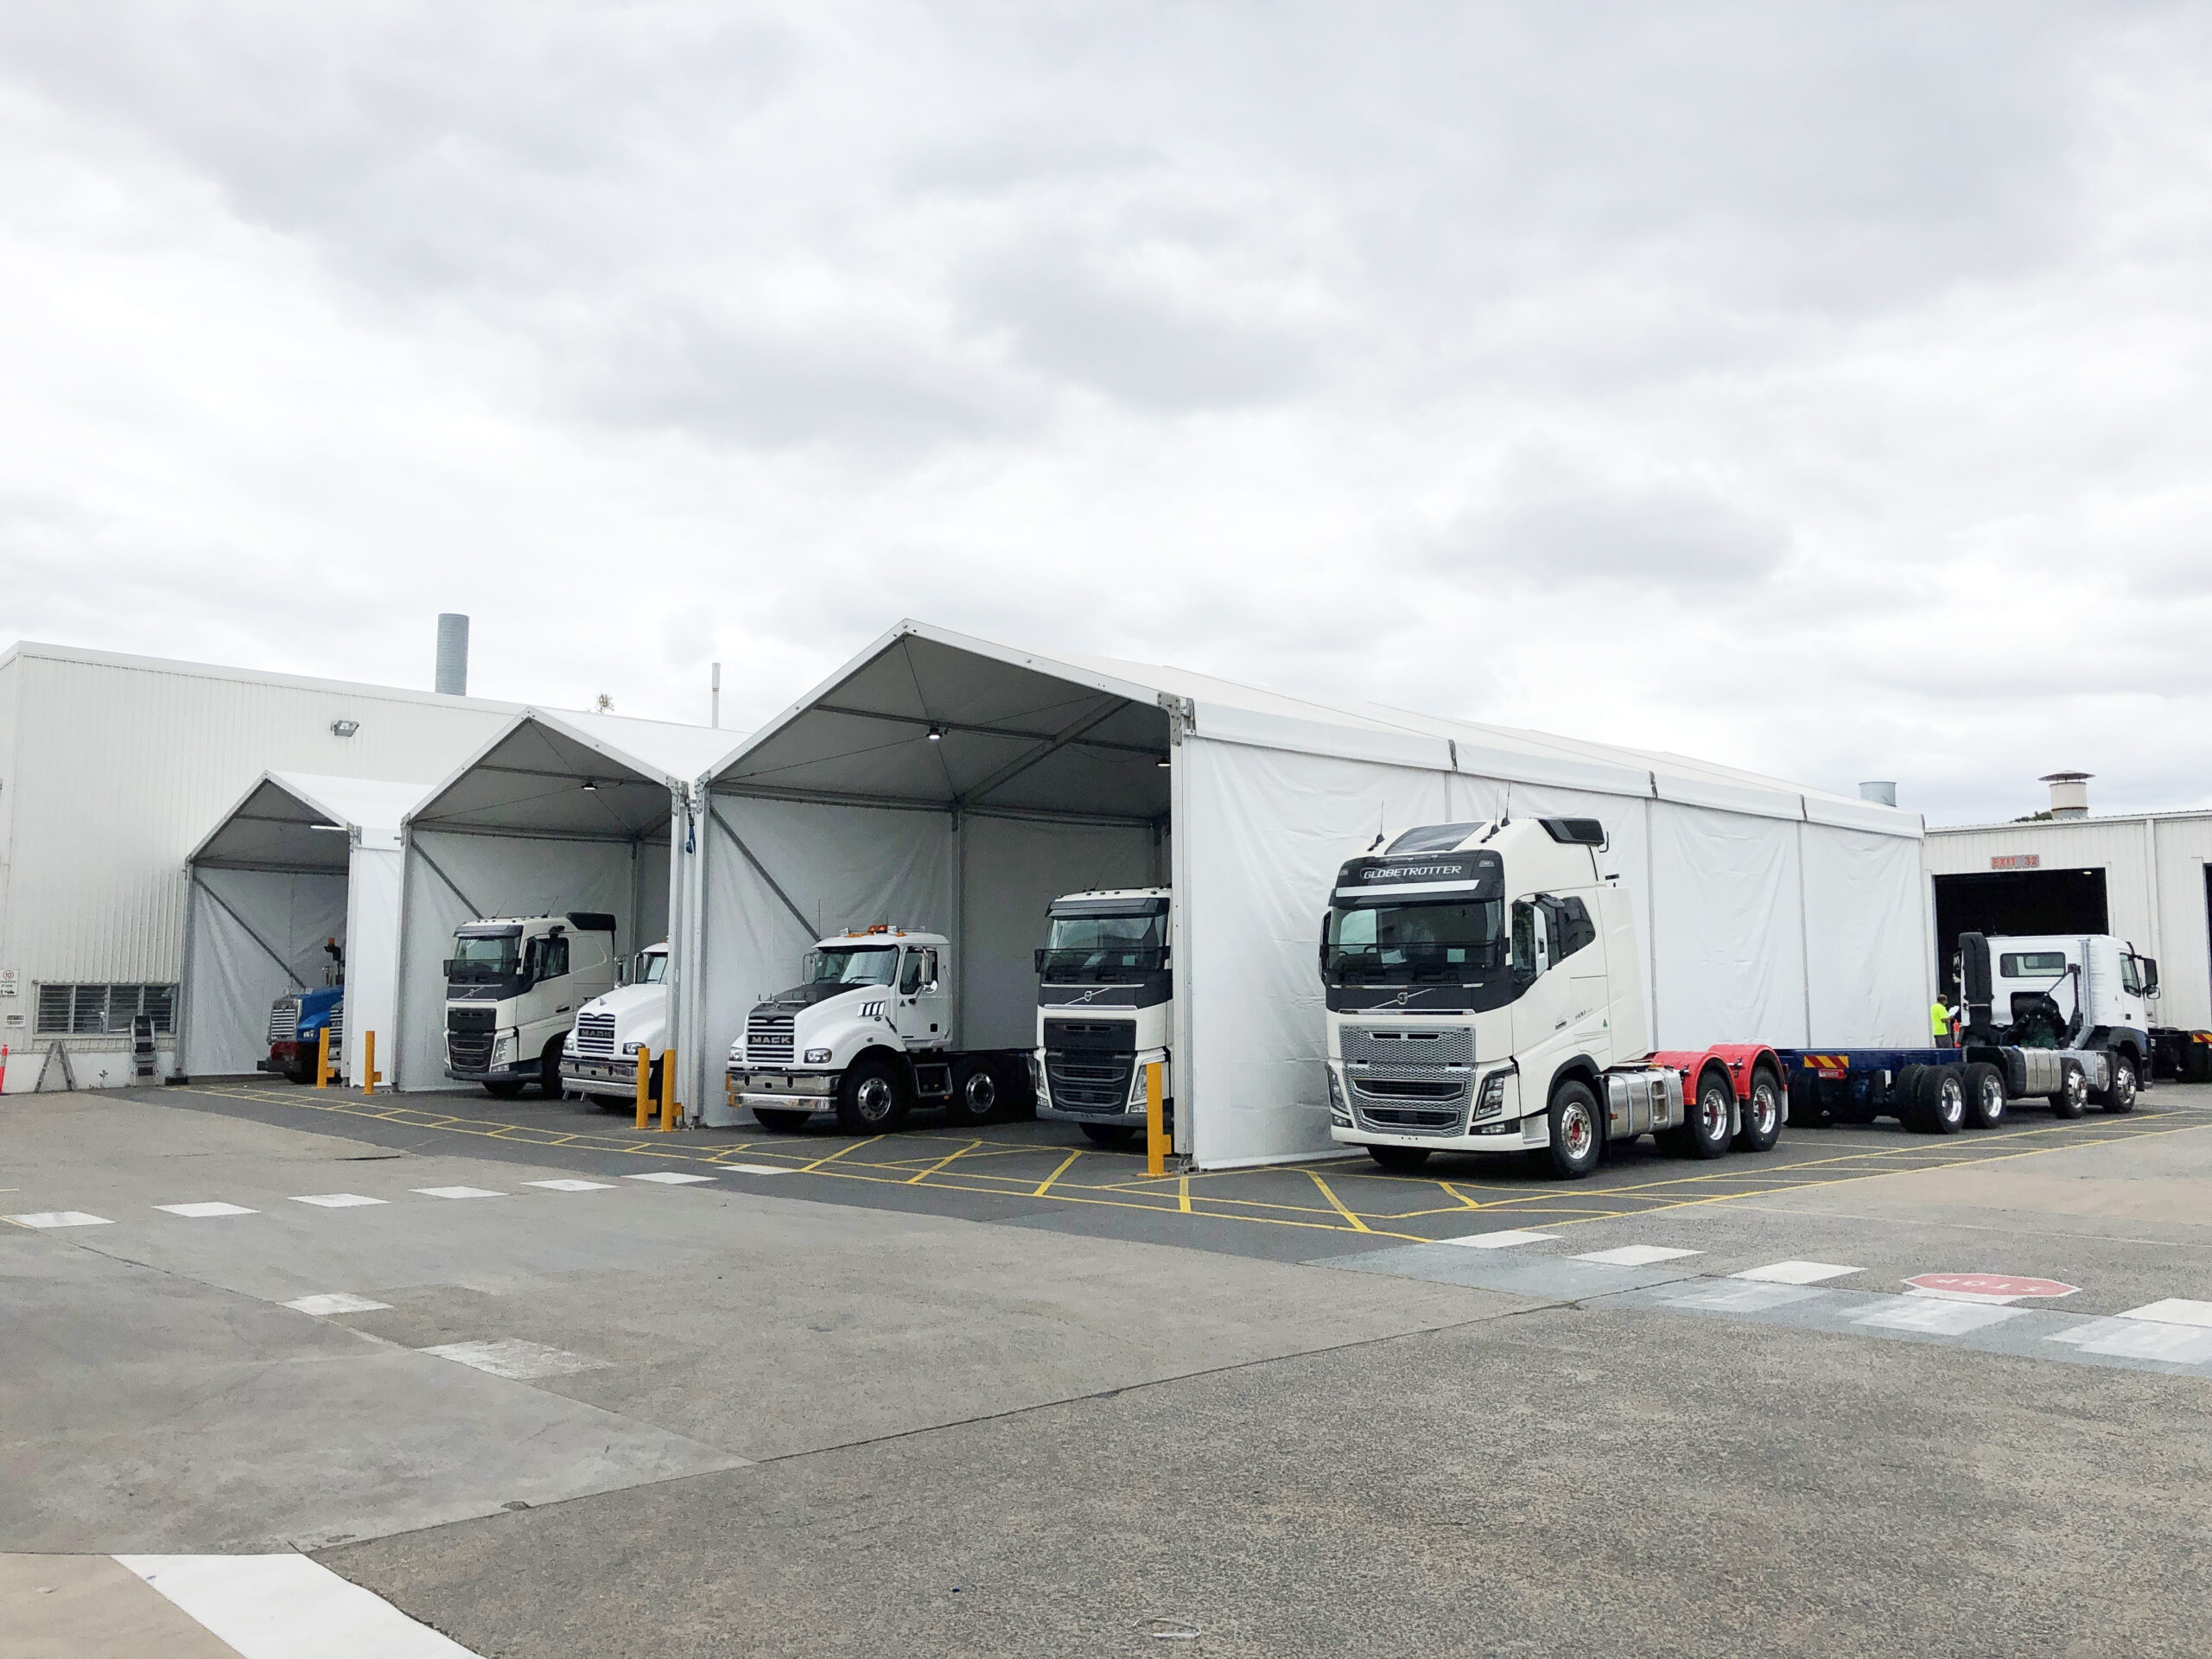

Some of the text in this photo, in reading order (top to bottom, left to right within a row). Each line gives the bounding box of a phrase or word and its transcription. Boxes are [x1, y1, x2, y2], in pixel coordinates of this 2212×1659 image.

[2024, 855, 2037, 866] 32
[1363, 865, 1462, 880] GLOBETROTTER
[1936, 1278, 2042, 1293] STOP
